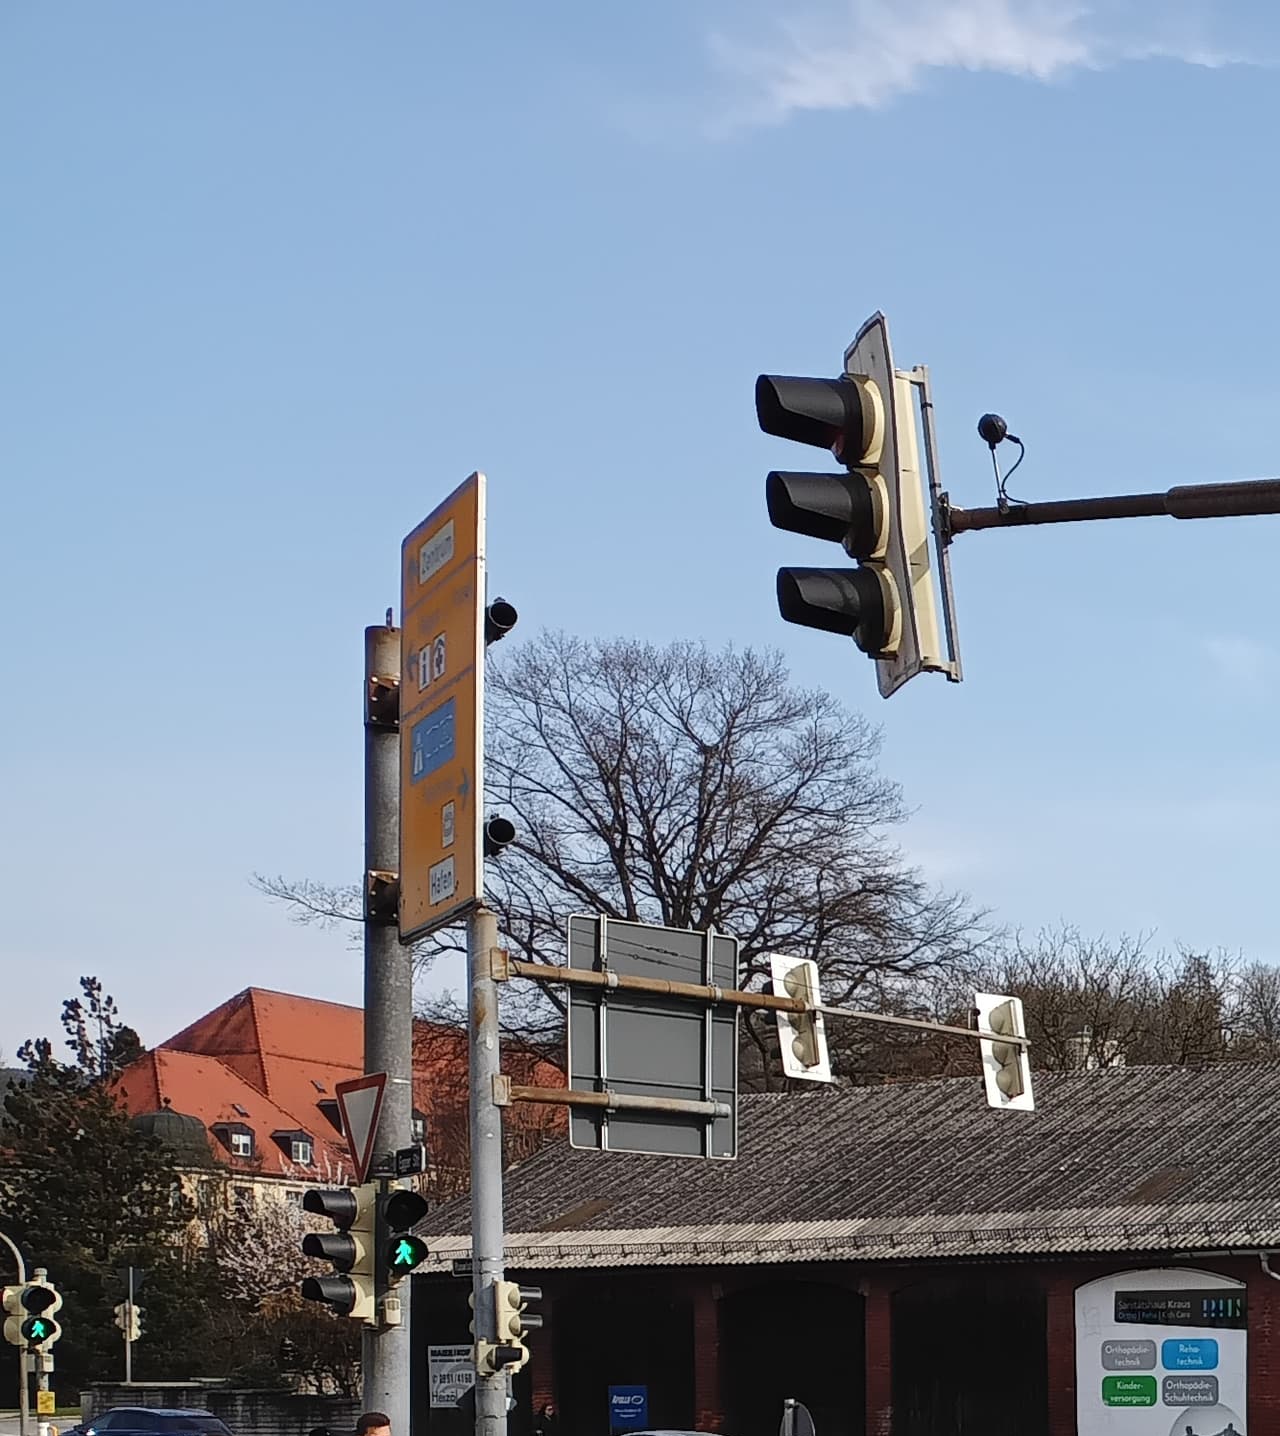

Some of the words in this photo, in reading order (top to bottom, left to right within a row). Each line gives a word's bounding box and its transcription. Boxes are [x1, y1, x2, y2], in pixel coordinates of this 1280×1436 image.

[431, 870, 451, 897] Hafen
[1168, 1301, 1191, 1309] Kraus
[1105, 1344, 1150, 1355] Orthopädie-
[1179, 1343, 1200, 1353] Reha-
[1115, 1357, 1140, 1366] technik
[1176, 1357, 1203, 1366] technik
[1116, 1381, 1143, 1390] Kinder-
[1166, 1380, 1212, 1391] Orthopädie-
[1110, 1396, 1150, 1404] versorgung
[1165, 1393, 1213, 1402] Schuhtechnik
